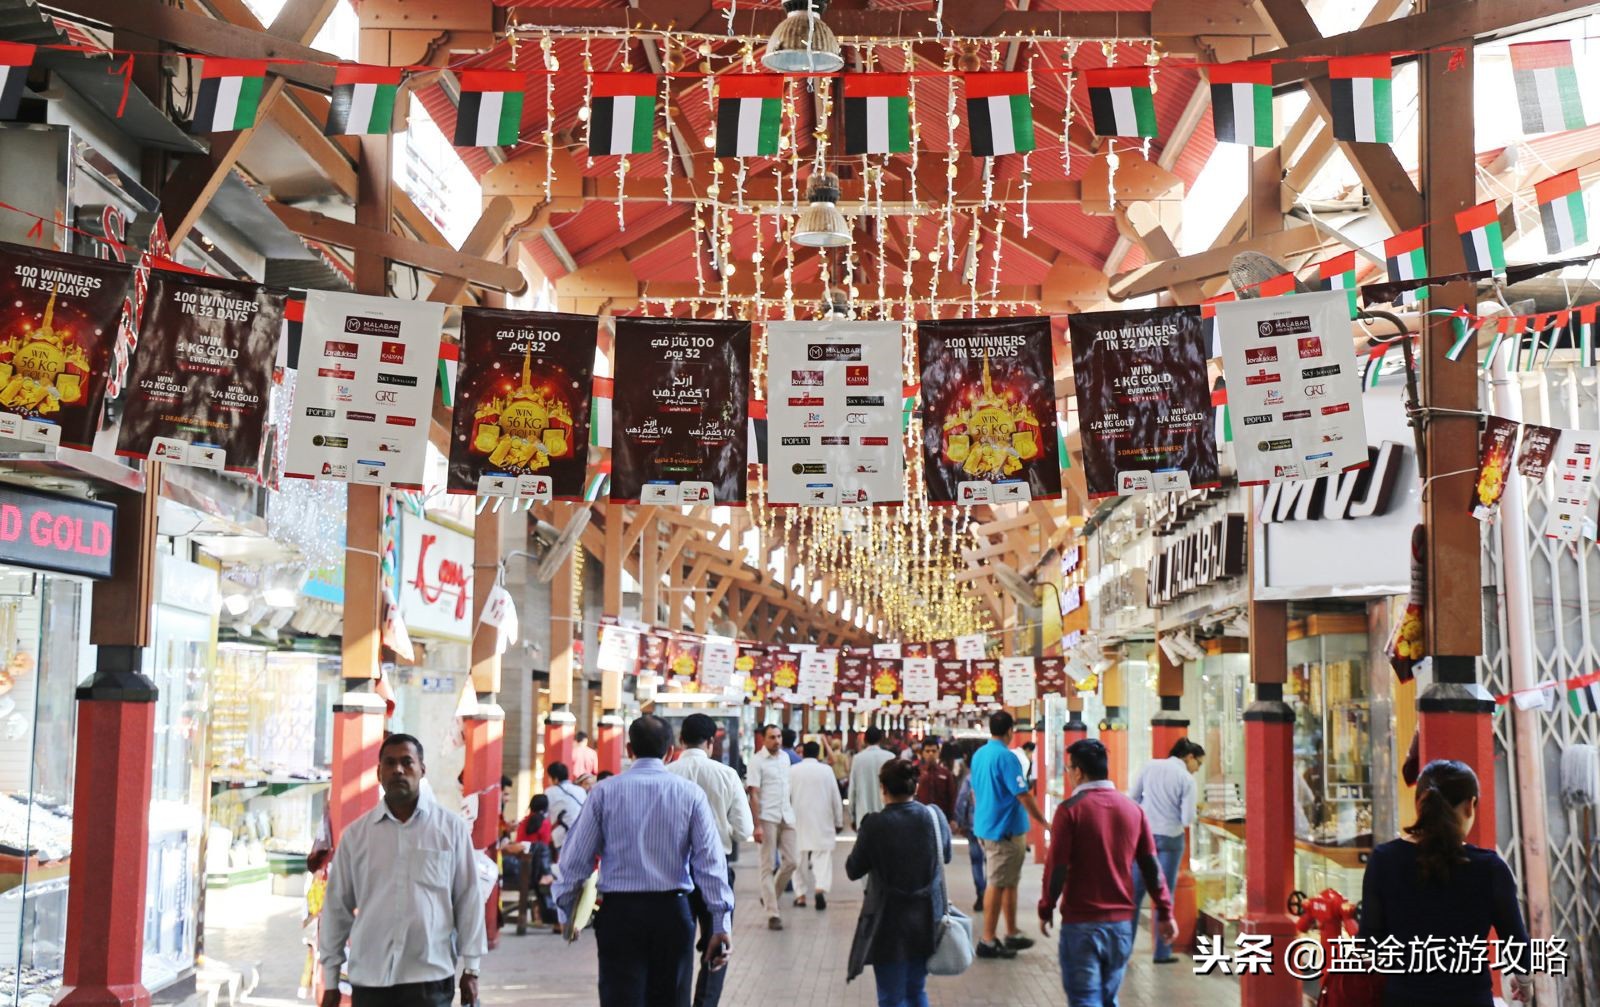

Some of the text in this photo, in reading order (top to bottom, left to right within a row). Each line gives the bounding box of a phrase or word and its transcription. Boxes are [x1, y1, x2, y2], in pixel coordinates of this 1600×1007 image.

[15, 265, 102, 289] 100 WINNERS
[21, 277, 91, 298] IN 32 DAYS
[174, 291, 259, 312] 100 WINNERS
[181, 303, 248, 321] IN 32 DAYS
[363, 321, 399, 331] MALABAR
[1275, 320, 1309, 328] MALABAR
[496, 329, 561, 341] 100 فائز في
[1096, 324, 1178, 341] 100 WINNERS
[199, 335, 221, 346] WIN
[531, 341, 546, 352] 32
[651, 336, 715, 348] 100 فائز في
[945, 335, 1026, 348] 100 WINNERS
[1106, 336, 1170, 350] IN 32 DAYS
[31, 349, 49, 359] WIN
[177, 342, 239, 359] 1 KG GOLD
[664, 348, 700, 360] 32 يوم
[954, 346, 1018, 358] IN 32 DAYS
[20, 356, 58, 373] 56 KG
[189, 356, 224, 366] EVERYDAY
[1130, 365, 1152, 375] WIN
[157, 375, 173, 383] WIN
[672, 375, 693, 387] اربح
[1113, 373, 1172, 387] 1 KG GOLD
[140, 380, 188, 393] 1/2 KG GOLD
[228, 385, 243, 393] WIN
[1127, 386, 1160, 395] EVERYDAY
[1304, 383, 1325, 396] GRT
[225, 391, 236, 400] KG
[237, 393, 258, 403] GOLD
[375, 390, 398, 402] GRT
[705, 388, 710, 398] 1
[515, 408, 533, 417] WIN
[846, 412, 868, 424] GRT
[1104, 413, 1119, 421] WIN
[1170, 414, 1181, 422] KG
[1182, 412, 1203, 421] GOLD
[507, 417, 542, 430] 56 KG
[981, 415, 999, 423] WIN
[1090, 418, 1135, 430] 1/2 KG GOLD
[723, 429, 736, 437] 1/2
[975, 423, 1009, 435] 56 KG
[30, 510, 112, 557] GOLD
